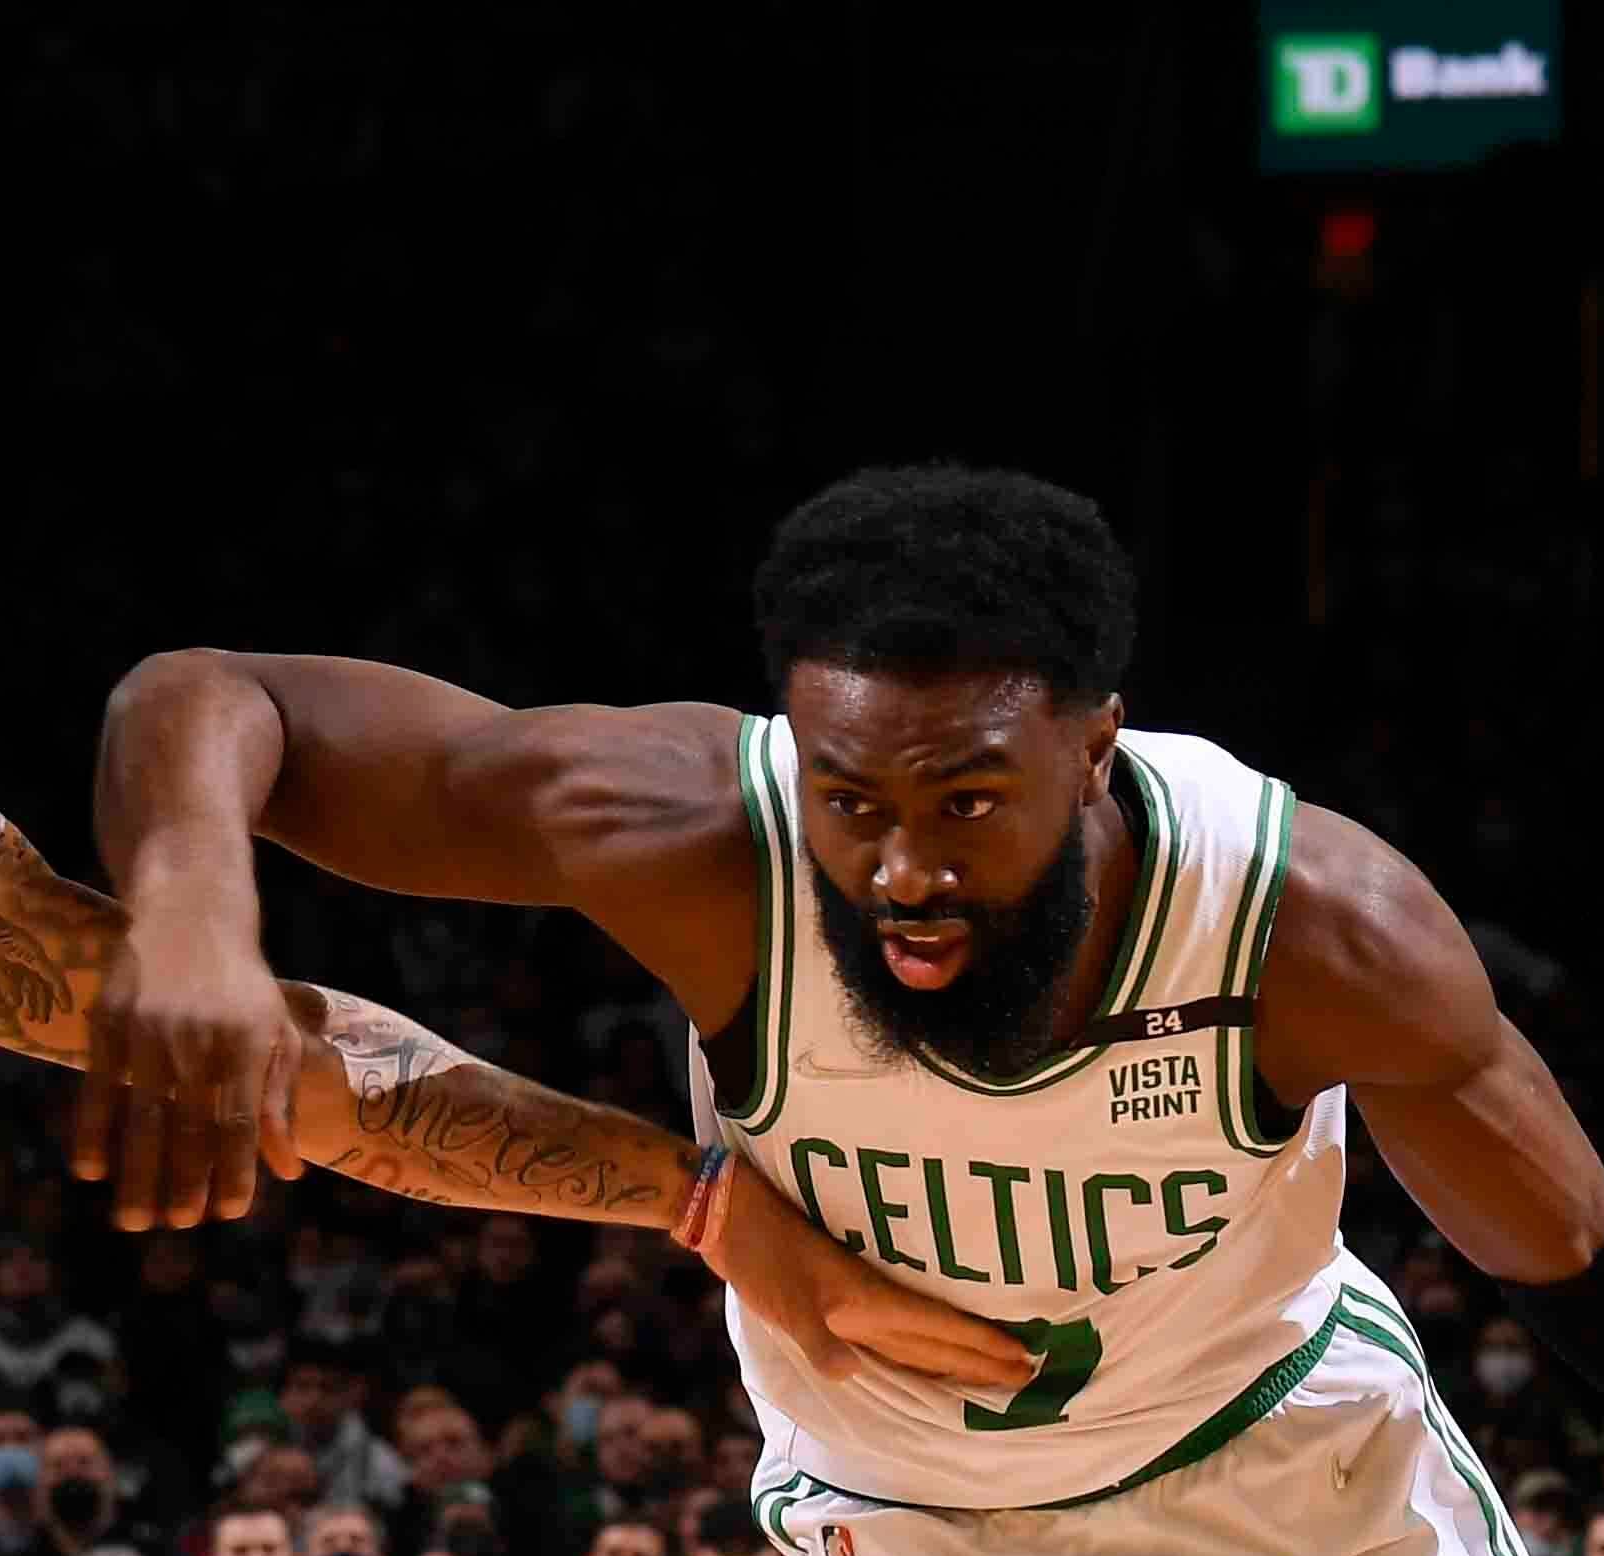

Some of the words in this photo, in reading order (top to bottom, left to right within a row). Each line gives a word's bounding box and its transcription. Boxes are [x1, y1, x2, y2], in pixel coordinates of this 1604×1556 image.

[1281, 46, 1371, 116] TD
[1390, 42, 1547, 99] Bank
[1145, 1009, 1183, 1036] 24
[1108, 1055, 1201, 1098] VISTA
[1110, 1089, 1202, 1124] PRINT
[789, 1137, 1231, 1296] CELTICS
